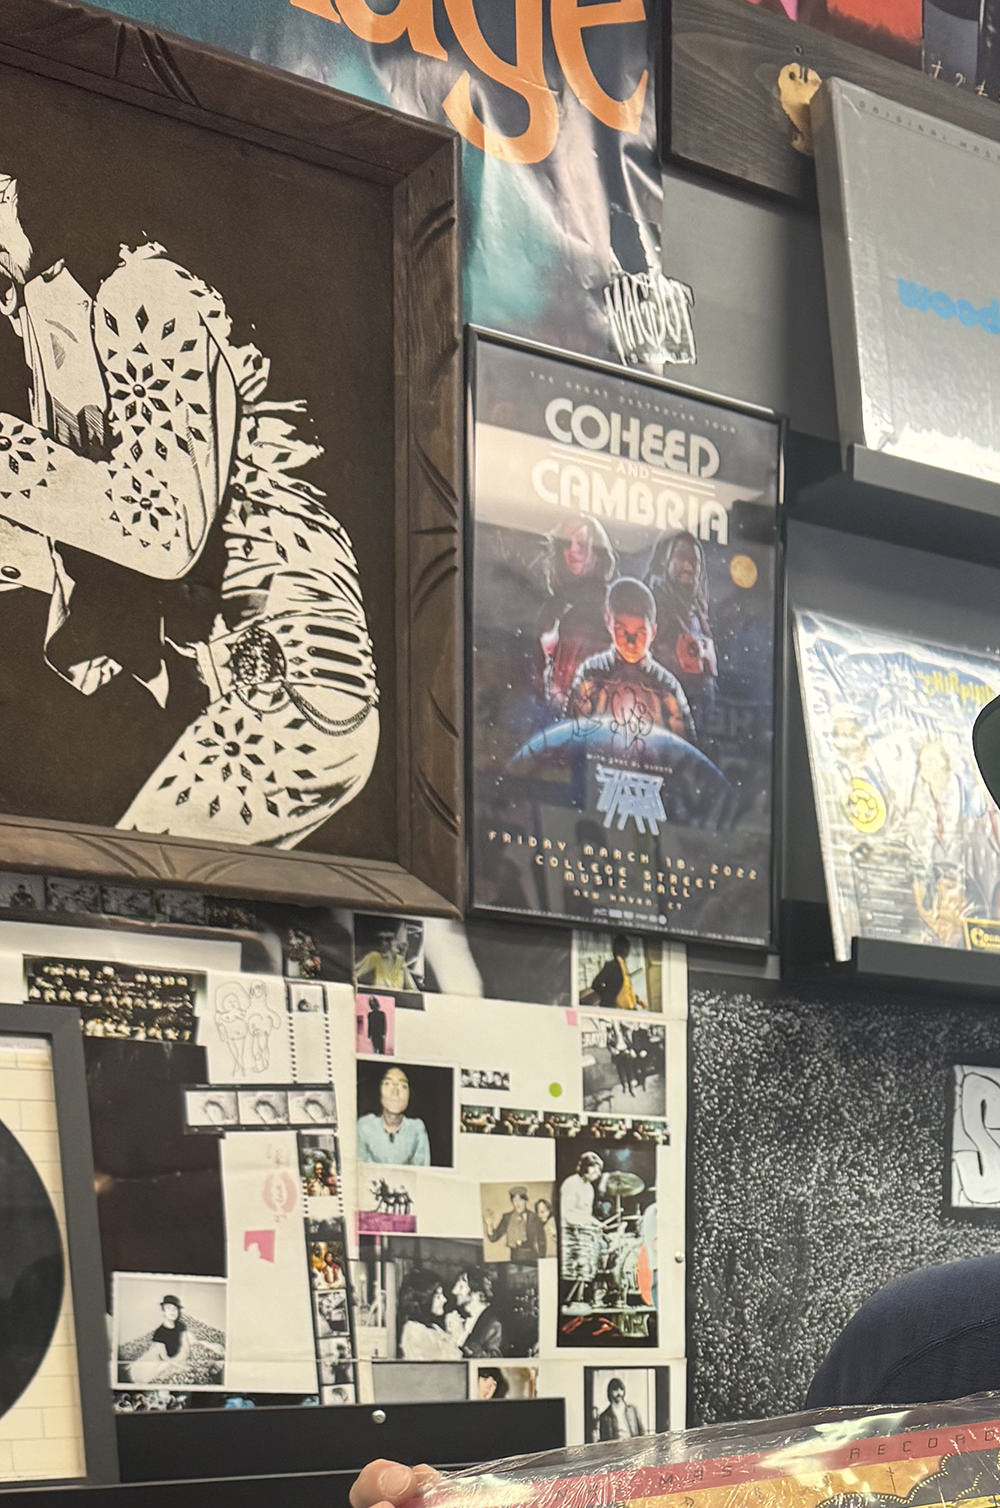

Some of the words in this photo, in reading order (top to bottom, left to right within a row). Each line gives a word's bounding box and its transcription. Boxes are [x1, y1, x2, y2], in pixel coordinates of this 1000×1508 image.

[545, 398, 720, 479] COHEED
[616, 462, 650, 479] AND
[531, 458, 729, 546] CAMBRIA
[488, 830, 567, 852] FRIDAY
[584, 845, 650, 865] MARCH
[710, 864, 758, 881] 2022
[535, 855, 628, 878] COLLEGE
[643, 870, 718, 891] STREET
[563, 871, 627, 890] MUSIC
[643, 883, 691, 899] HALL
